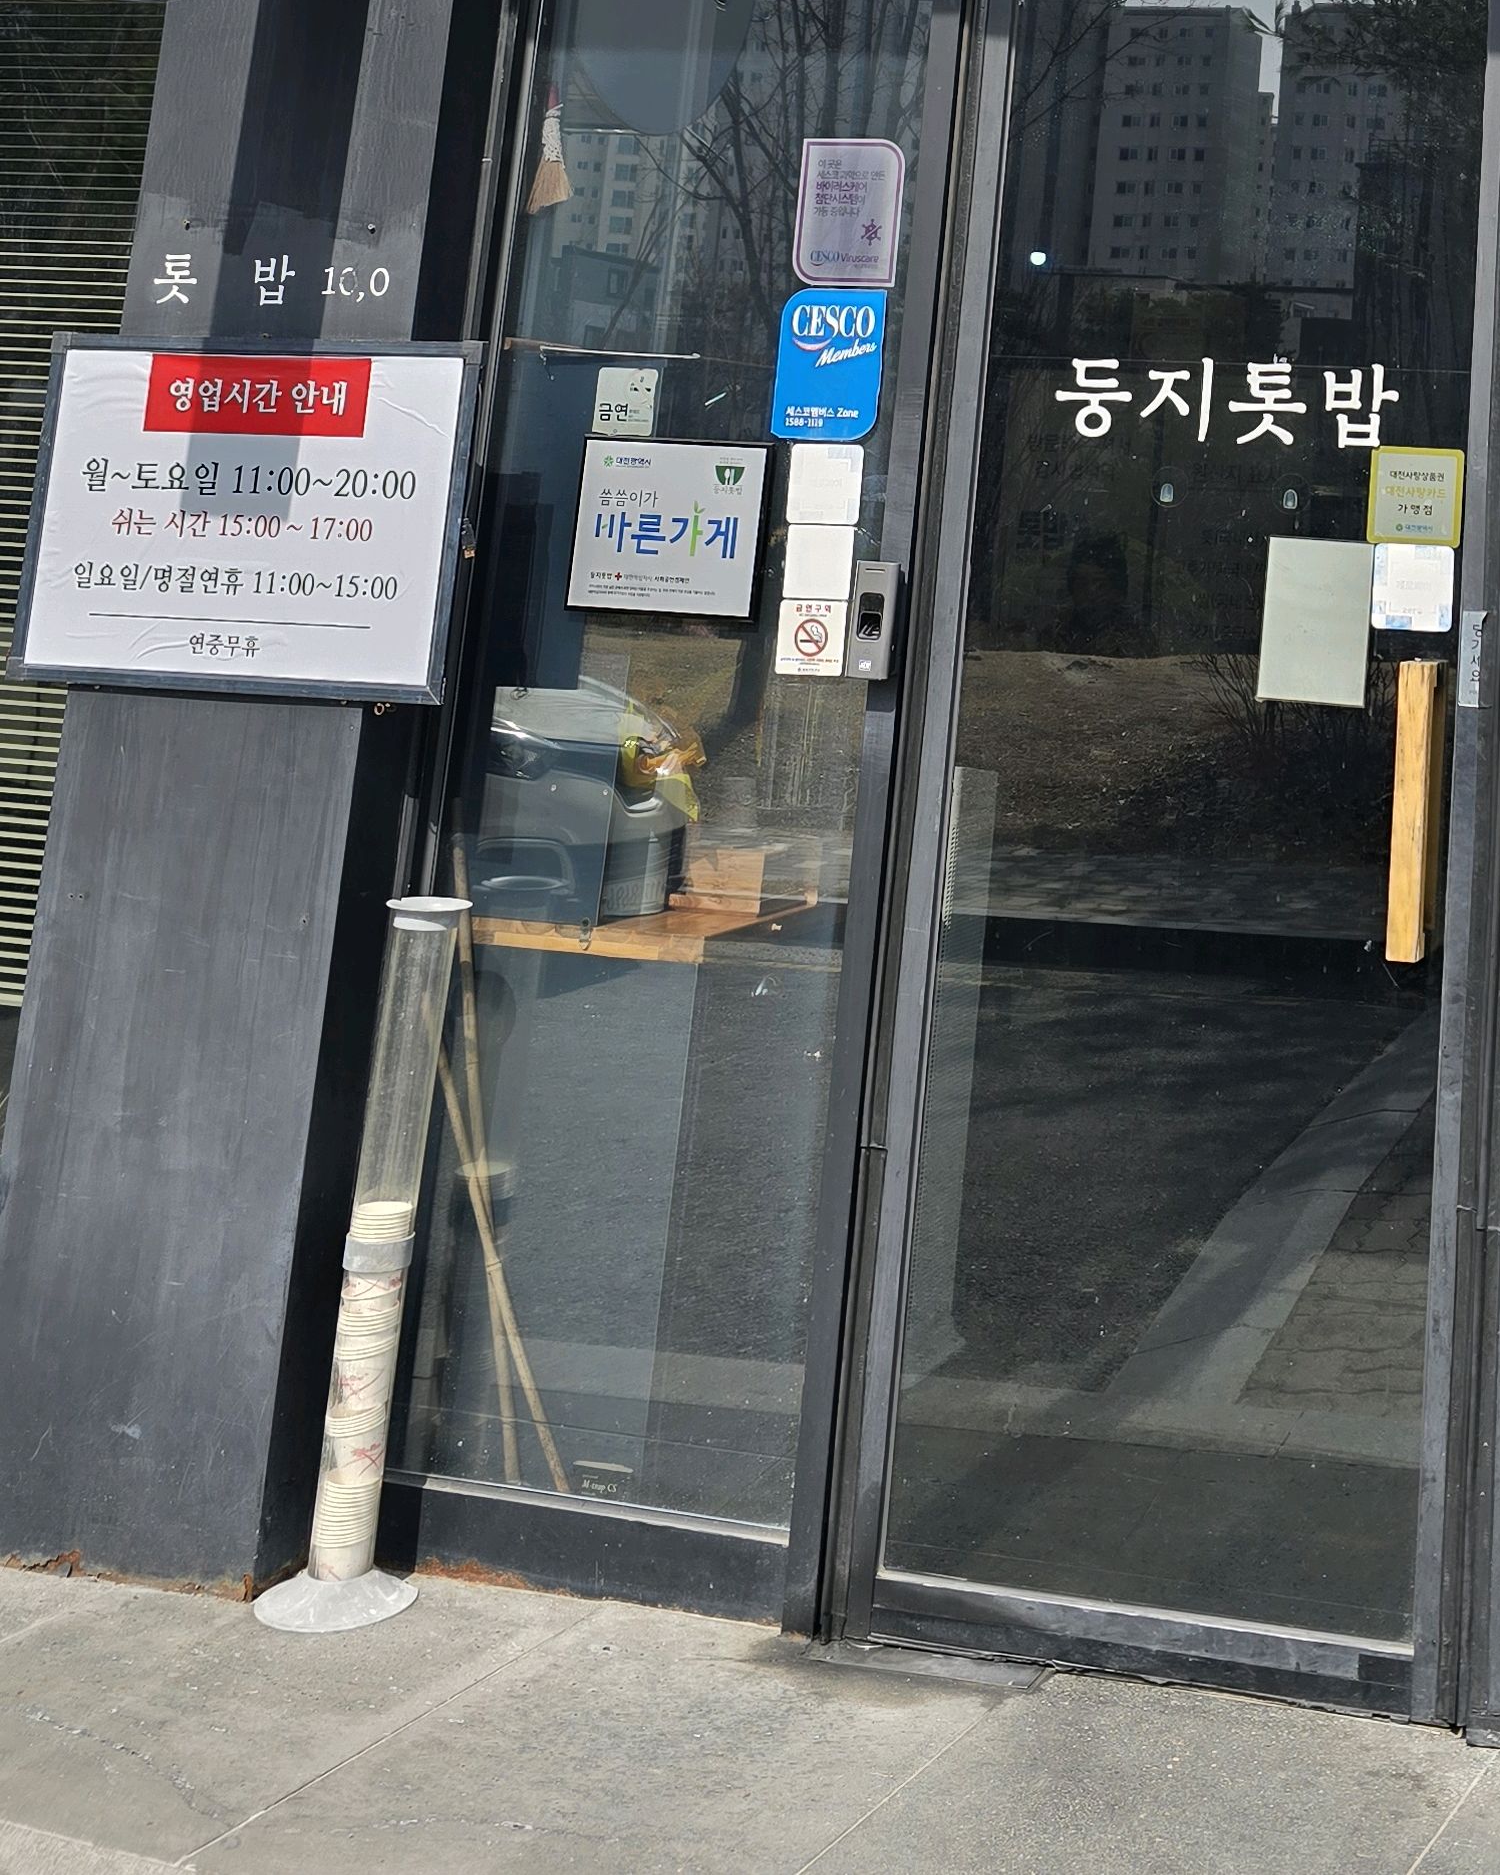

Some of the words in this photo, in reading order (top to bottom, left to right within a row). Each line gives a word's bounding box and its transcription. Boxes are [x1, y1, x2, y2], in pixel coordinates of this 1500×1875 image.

[810, 250, 840, 263] CESCO
[840, 252, 879, 263] Viruscare
[153, 253, 198, 304] 톳
[254, 254, 296, 306] 밥
[792, 305, 876, 338] CESCO
[815, 338, 877, 368] Members
[169, 378, 283, 416] 영업시간
[291, 379, 348, 417] 안내
[599, 403, 628, 422] 금연
[837, 408, 859, 418] Zone
[1055, 356, 1400, 449] 둥지톳밥
[82, 458, 221, 496] 월~토요일
[231, 465, 417, 500] 11:00~20:00
[598, 488, 660, 508] 씀씀이가
[111, 510, 156, 540] 쉬는
[163, 511, 211, 540] 시간
[217, 515, 280, 540] 15:00
[309, 516, 374, 543] 17:00
[594, 503, 740, 560] 바른가게
[73, 563, 244, 597] 일요일/명절연휴
[252, 572, 399, 602] 11:00~15:00
[188, 632, 261, 658] 연중무휴
